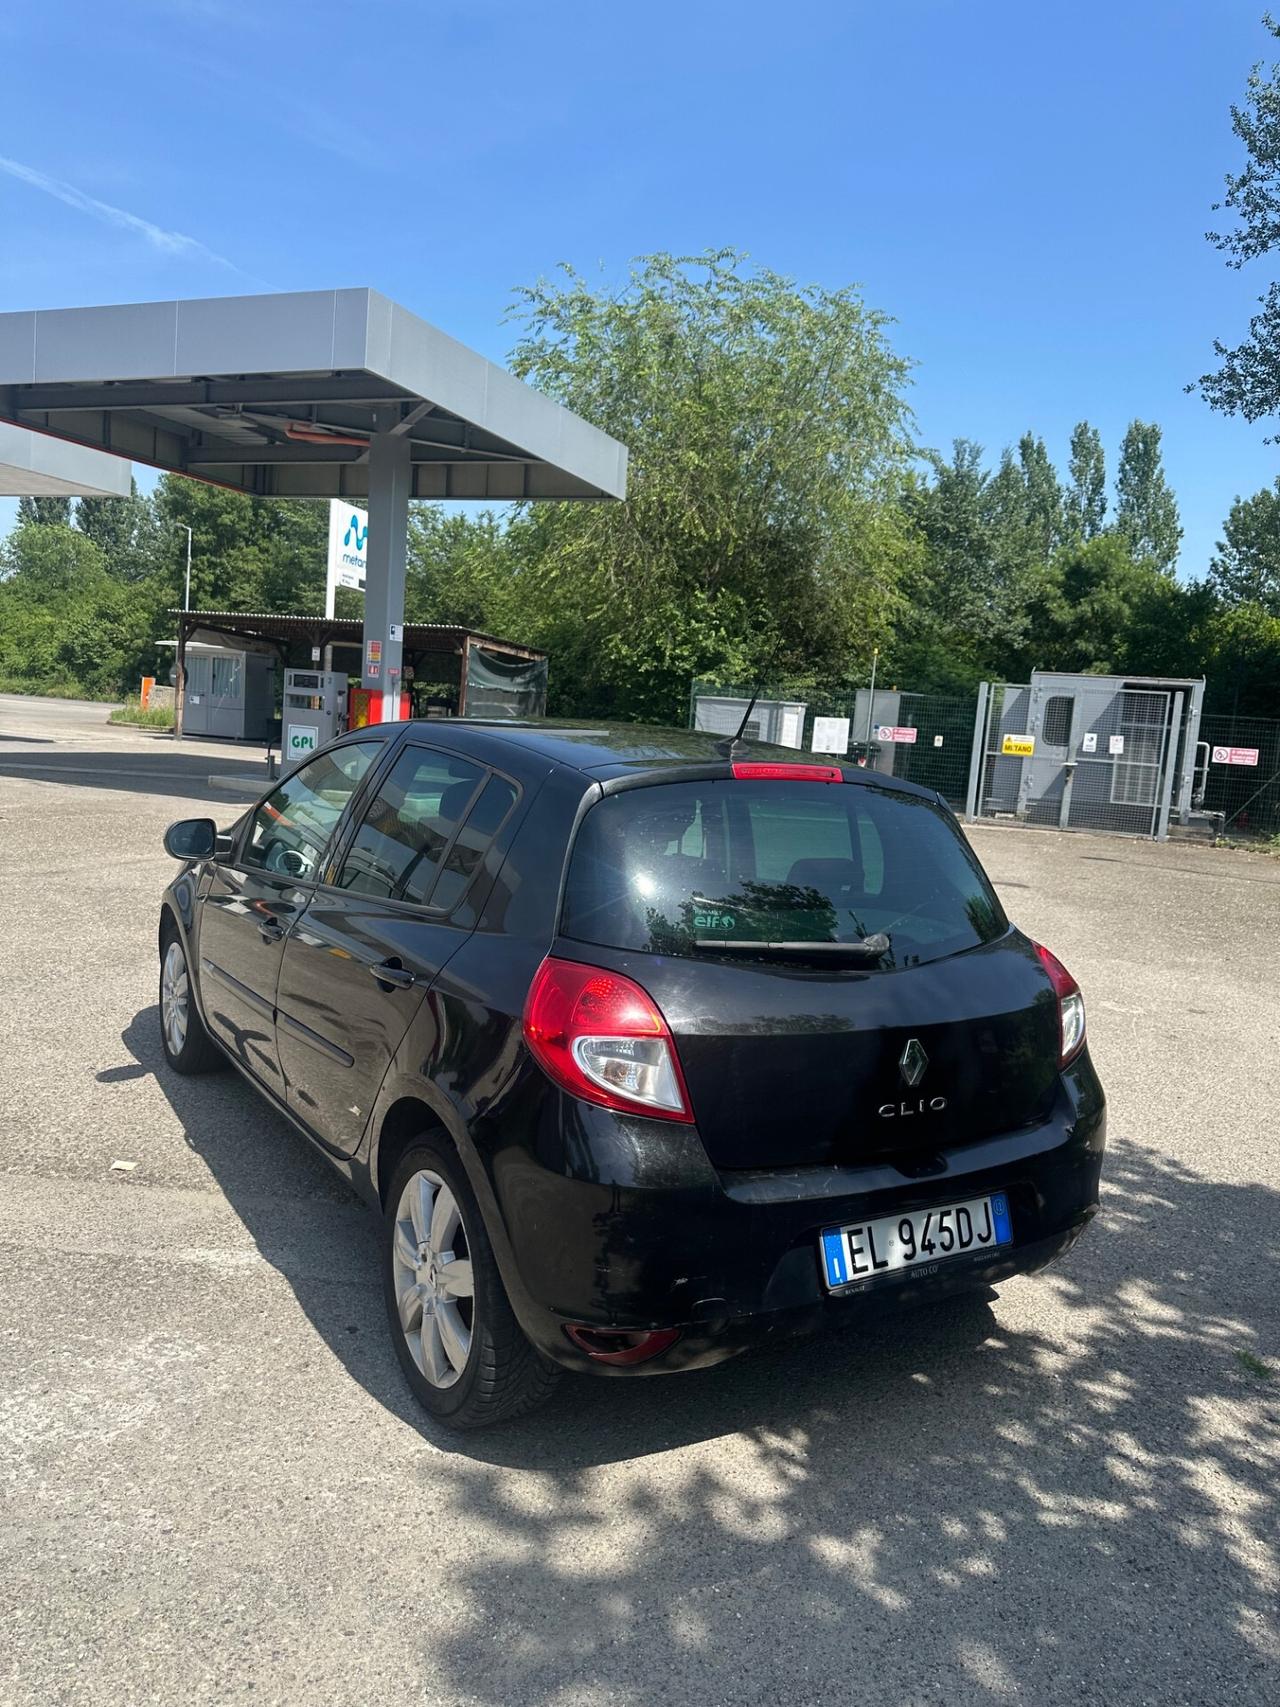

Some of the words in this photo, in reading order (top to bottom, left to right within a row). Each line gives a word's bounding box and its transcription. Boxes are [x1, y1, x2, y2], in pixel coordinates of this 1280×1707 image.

[342, 553, 367, 568] metan
[291, 735, 314, 749] GPL
[694, 915, 720, 928] elf
[878, 1097, 946, 1117] CLIO
[846, 1225, 889, 1275] EL
[898, 1202, 993, 1261] 945DJ
[833, 1258, 840, 1278] I
[911, 1268, 928, 1279] AUTO
